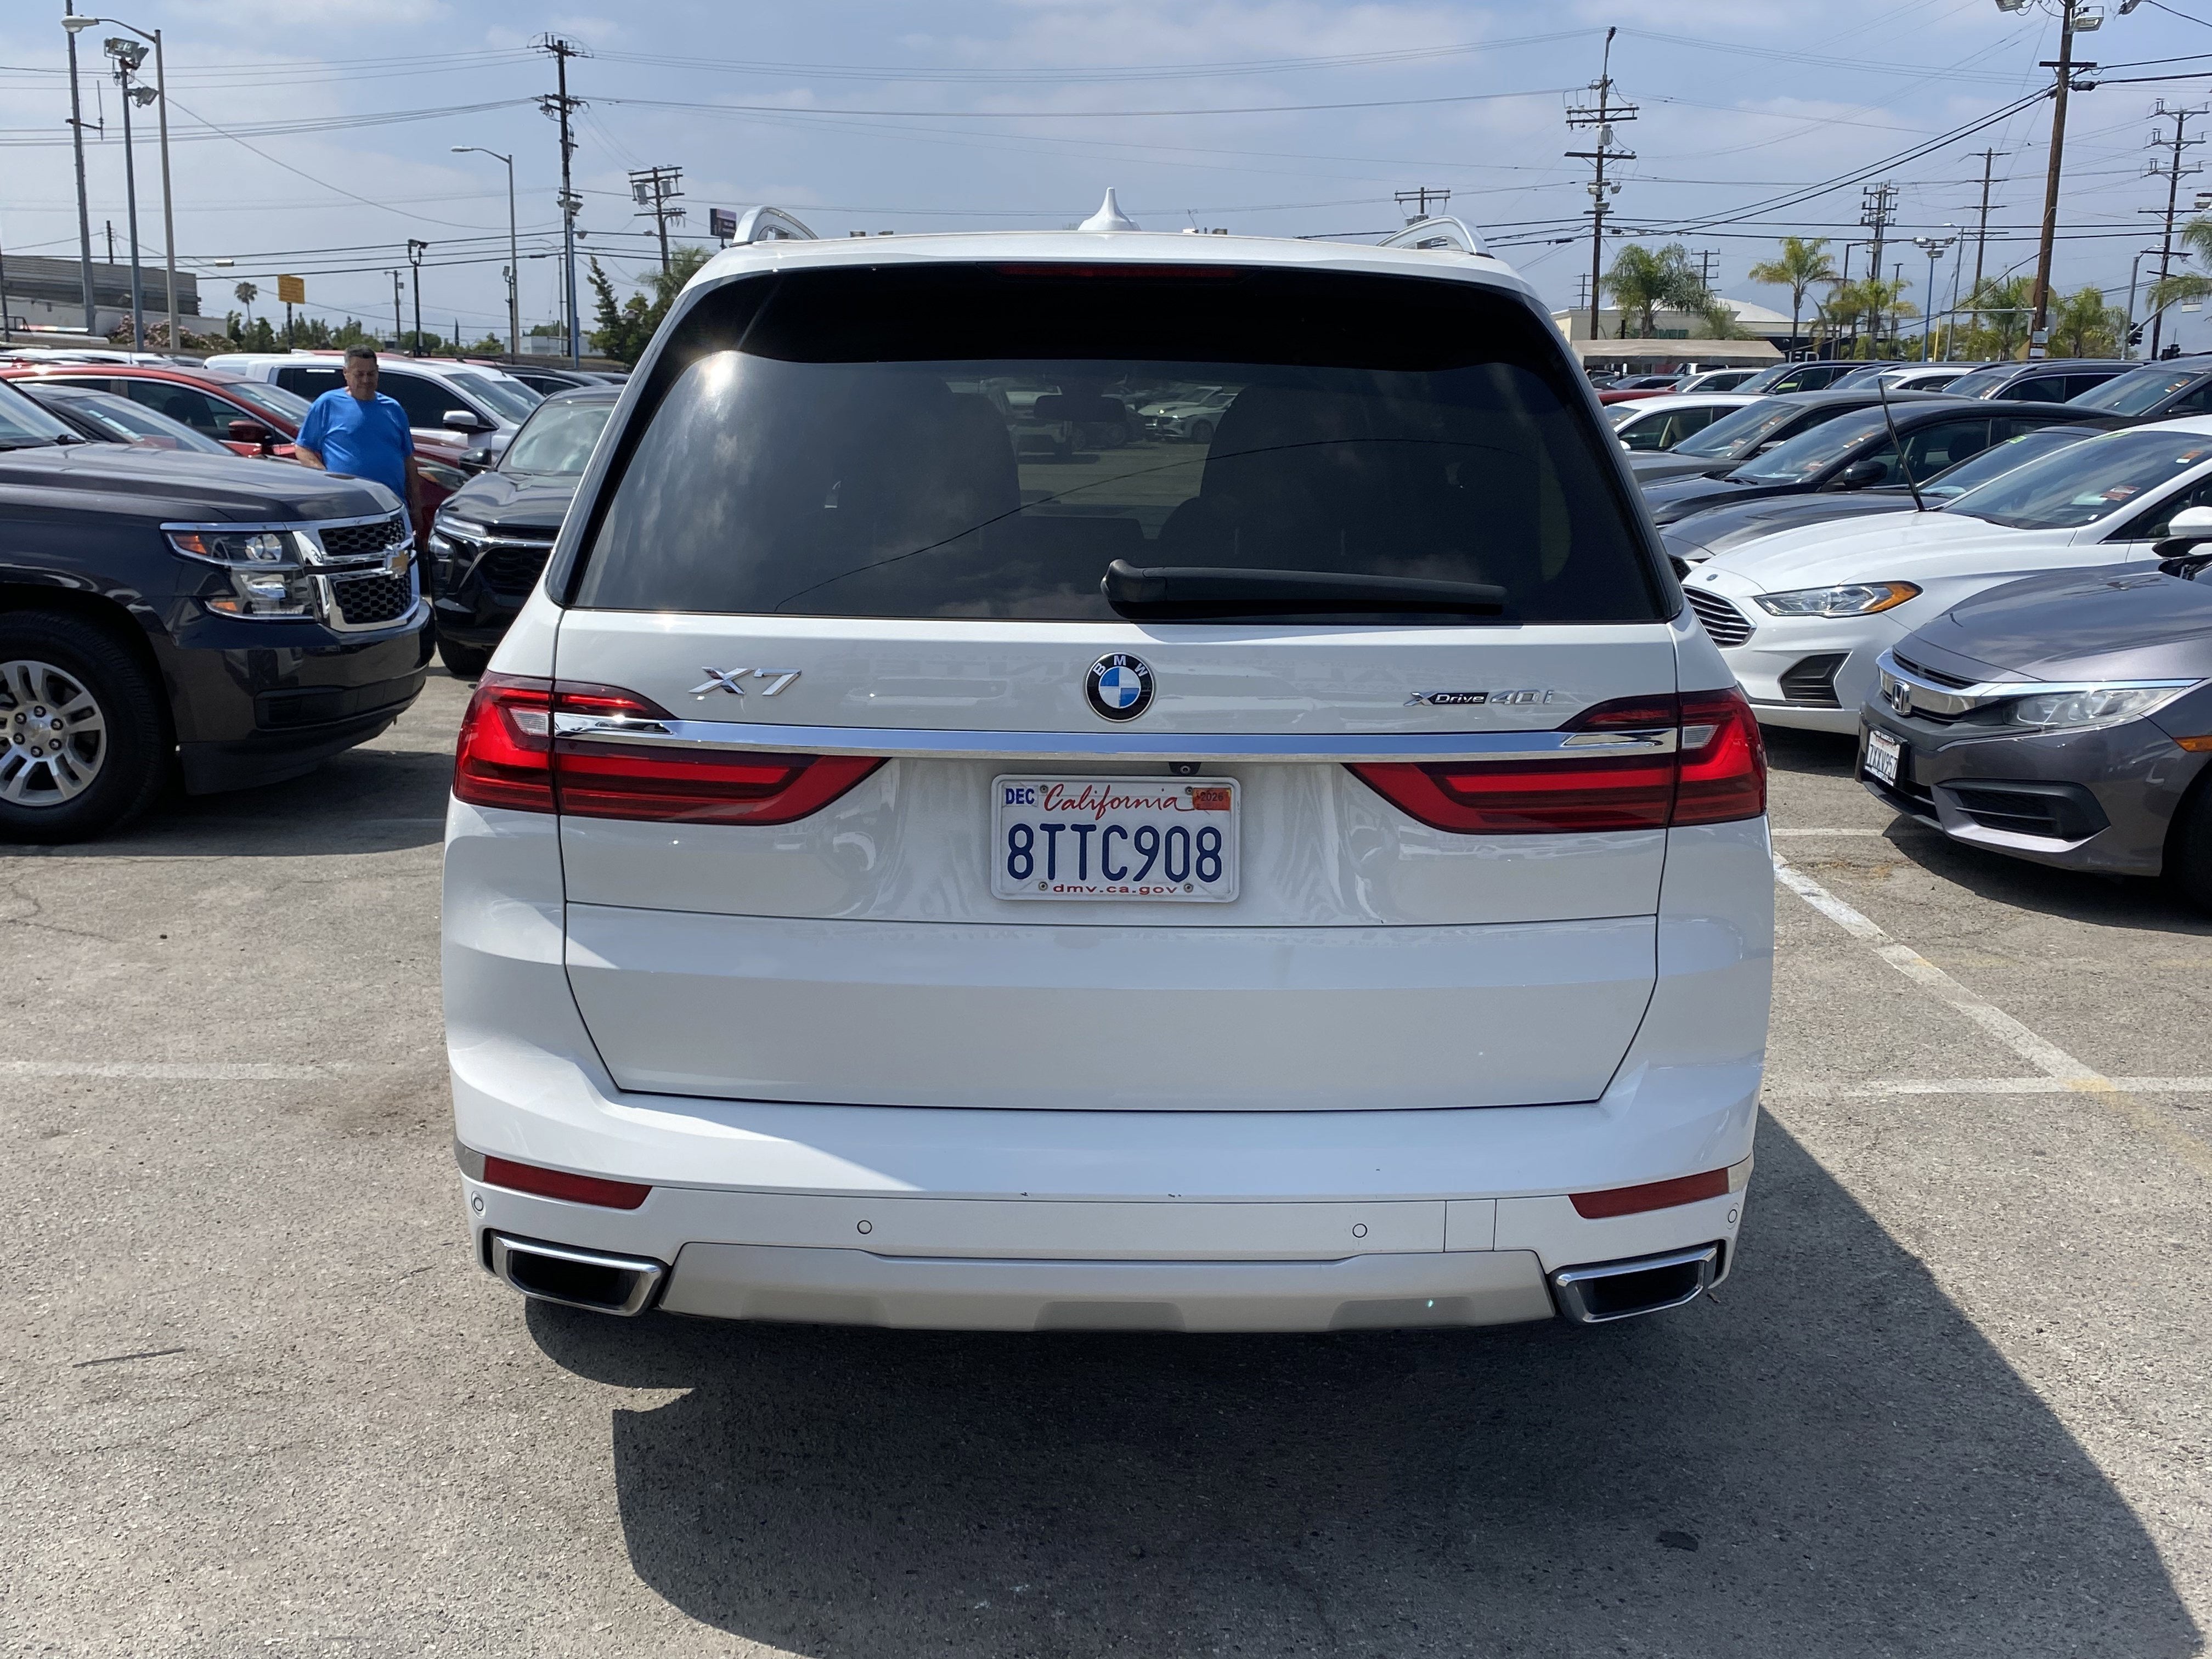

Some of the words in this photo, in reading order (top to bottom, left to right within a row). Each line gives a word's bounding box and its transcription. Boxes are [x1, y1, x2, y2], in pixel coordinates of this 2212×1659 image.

[1093, 655, 1148, 676] BMW
[688, 666, 802, 696] X7
[1869, 744, 1898, 778] 7XXV957
[1005, 788, 1035, 805] DEC
[1043, 783, 1195, 821] California
[1200, 792, 1223, 801] 2026
[1007, 823, 1222, 883] 8TTC908
[1053, 884, 1178, 895] dmv.ca.gov
